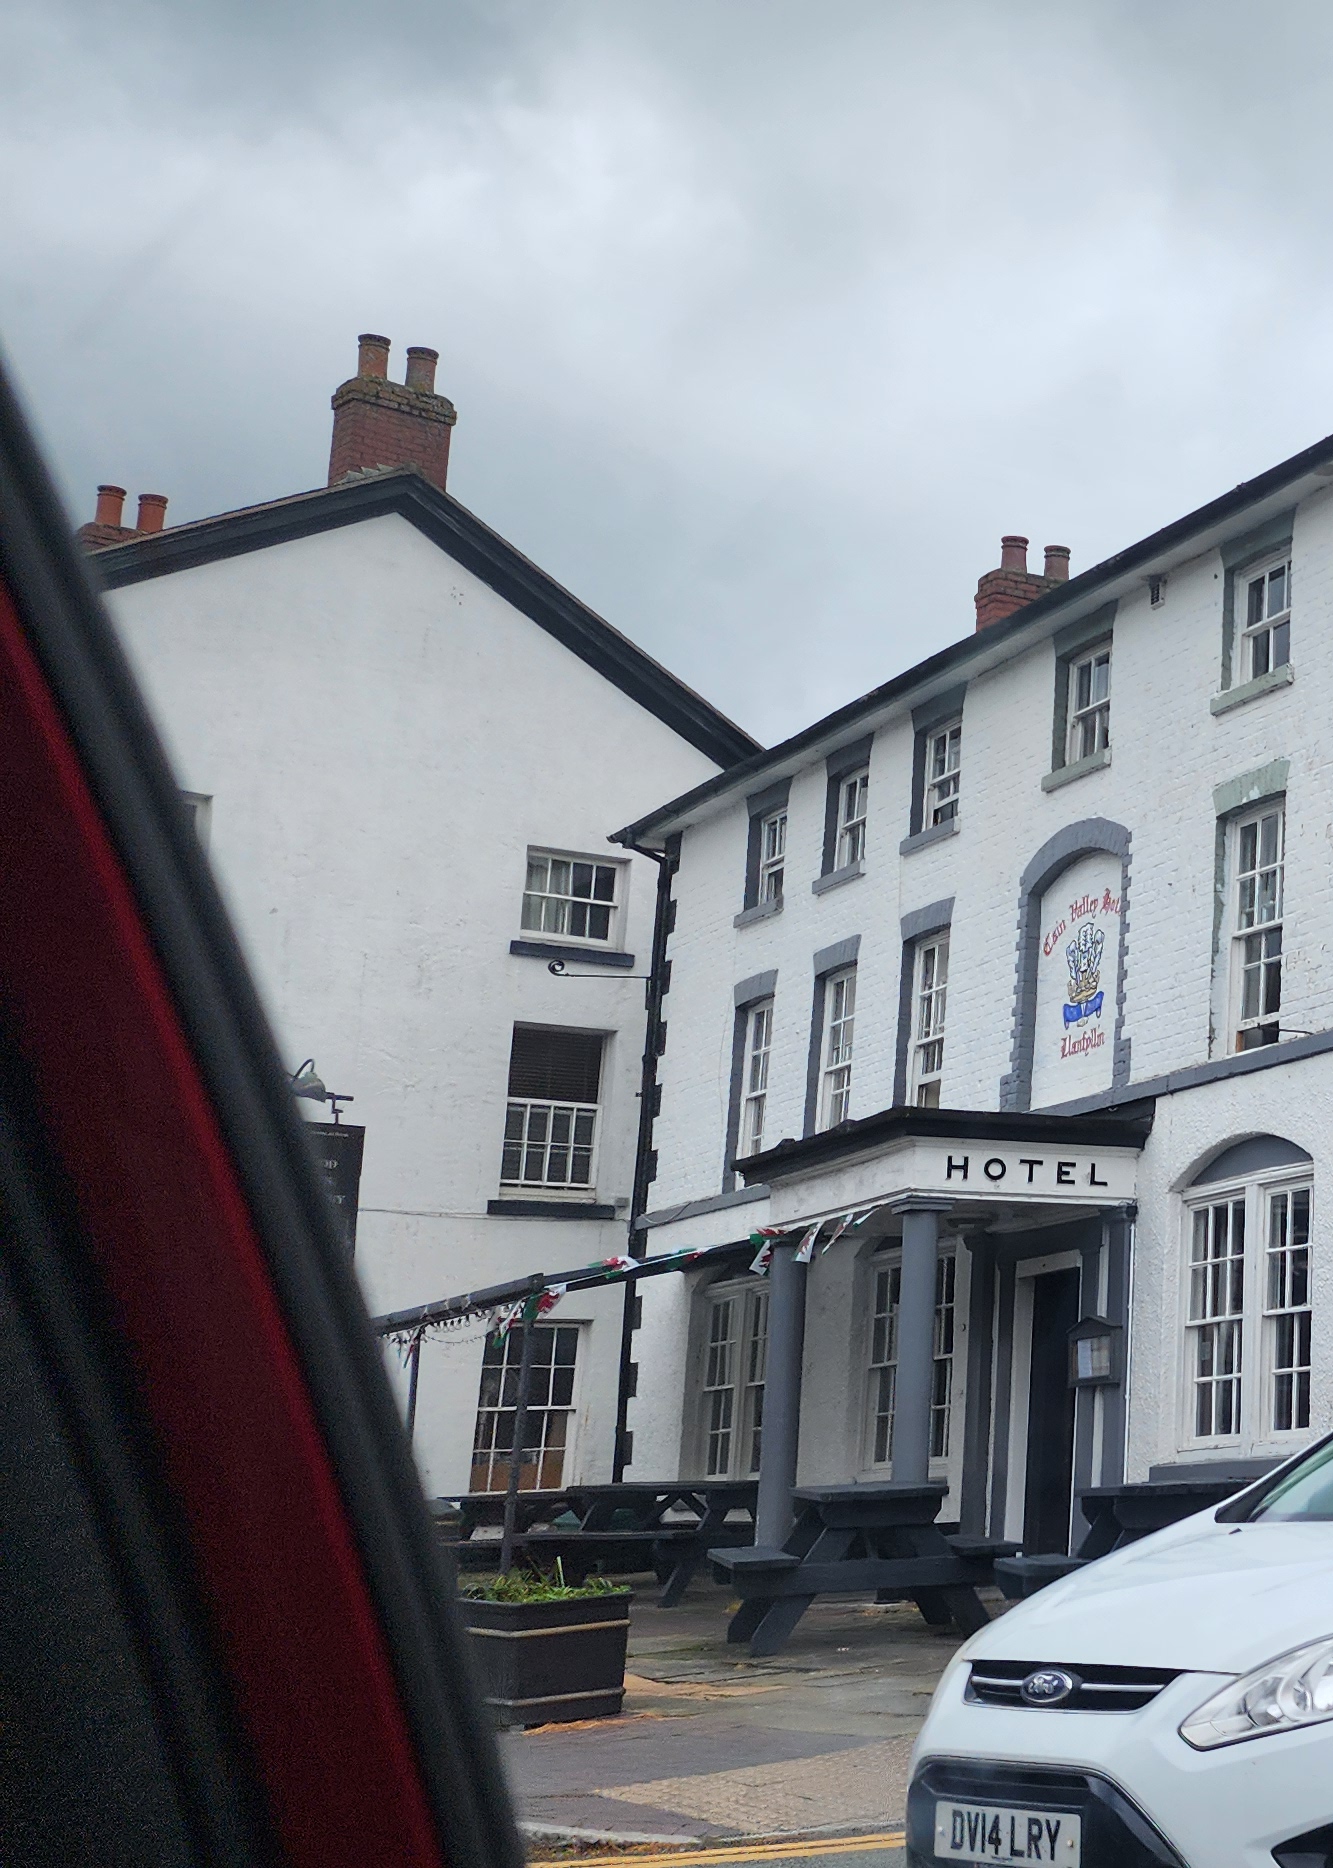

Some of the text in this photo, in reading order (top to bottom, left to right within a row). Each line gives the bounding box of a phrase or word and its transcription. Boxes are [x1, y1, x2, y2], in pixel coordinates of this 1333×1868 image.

[1069, 894, 1099, 923] Valley
[1061, 1024, 1105, 1059] Llanfyllin
[946, 1155, 1109, 1187] HOTEL
[951, 1809, 1061, 1861] DV14 LRY
